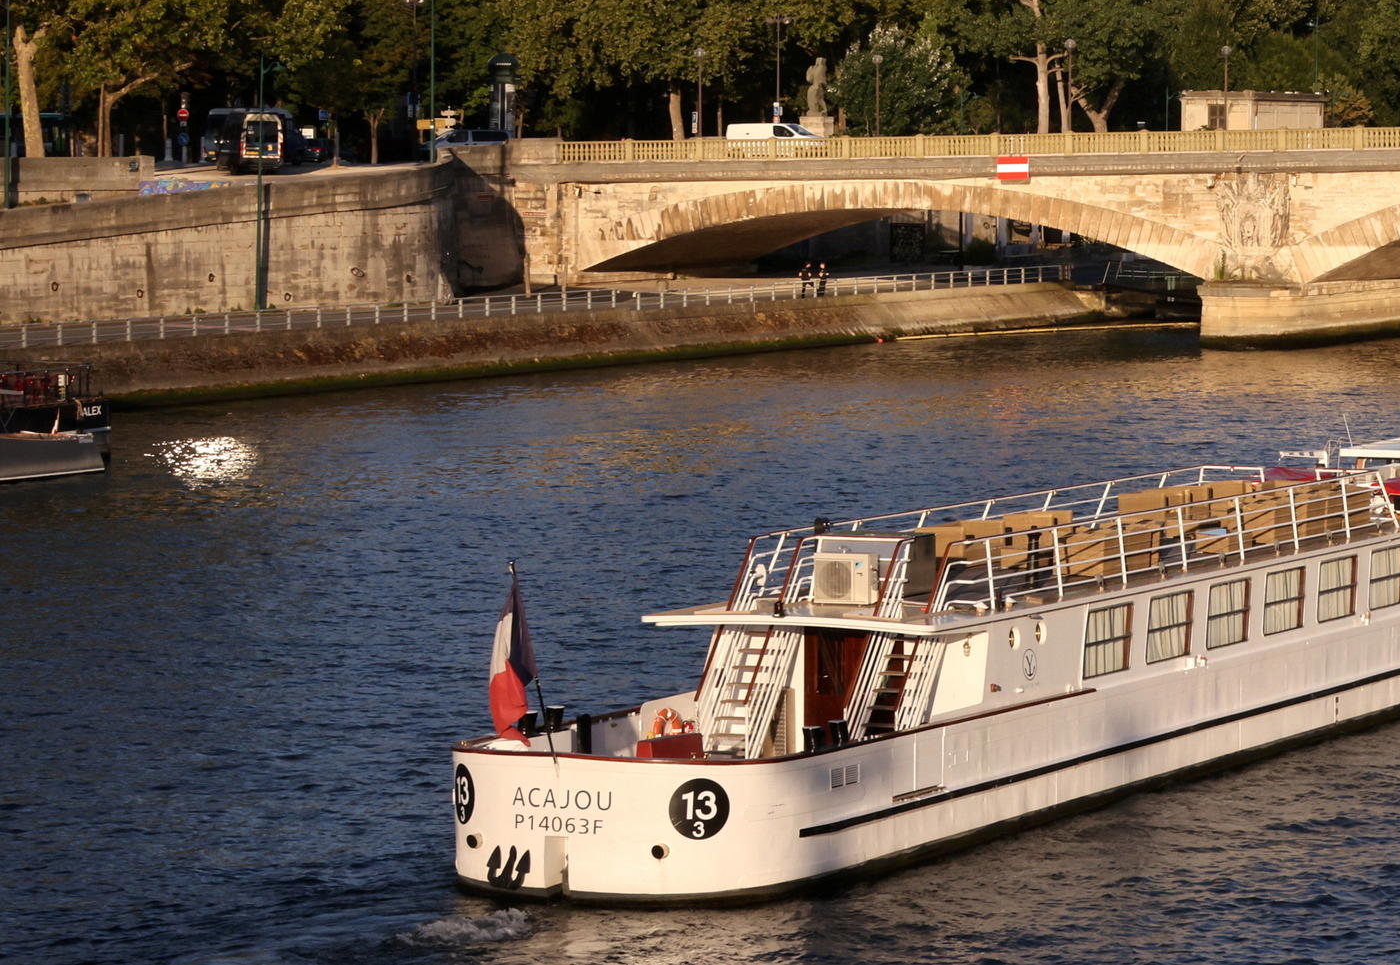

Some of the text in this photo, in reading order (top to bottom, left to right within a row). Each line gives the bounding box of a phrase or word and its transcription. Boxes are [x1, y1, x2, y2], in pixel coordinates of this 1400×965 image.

[456, 775, 470, 806] 13
[512, 786, 613, 811] ACAJOU
[460, 805, 466, 823] 3
[681, 790, 718, 821] 13
[514, 813, 604, 835] P14063F
[692, 820, 706, 838] 3
